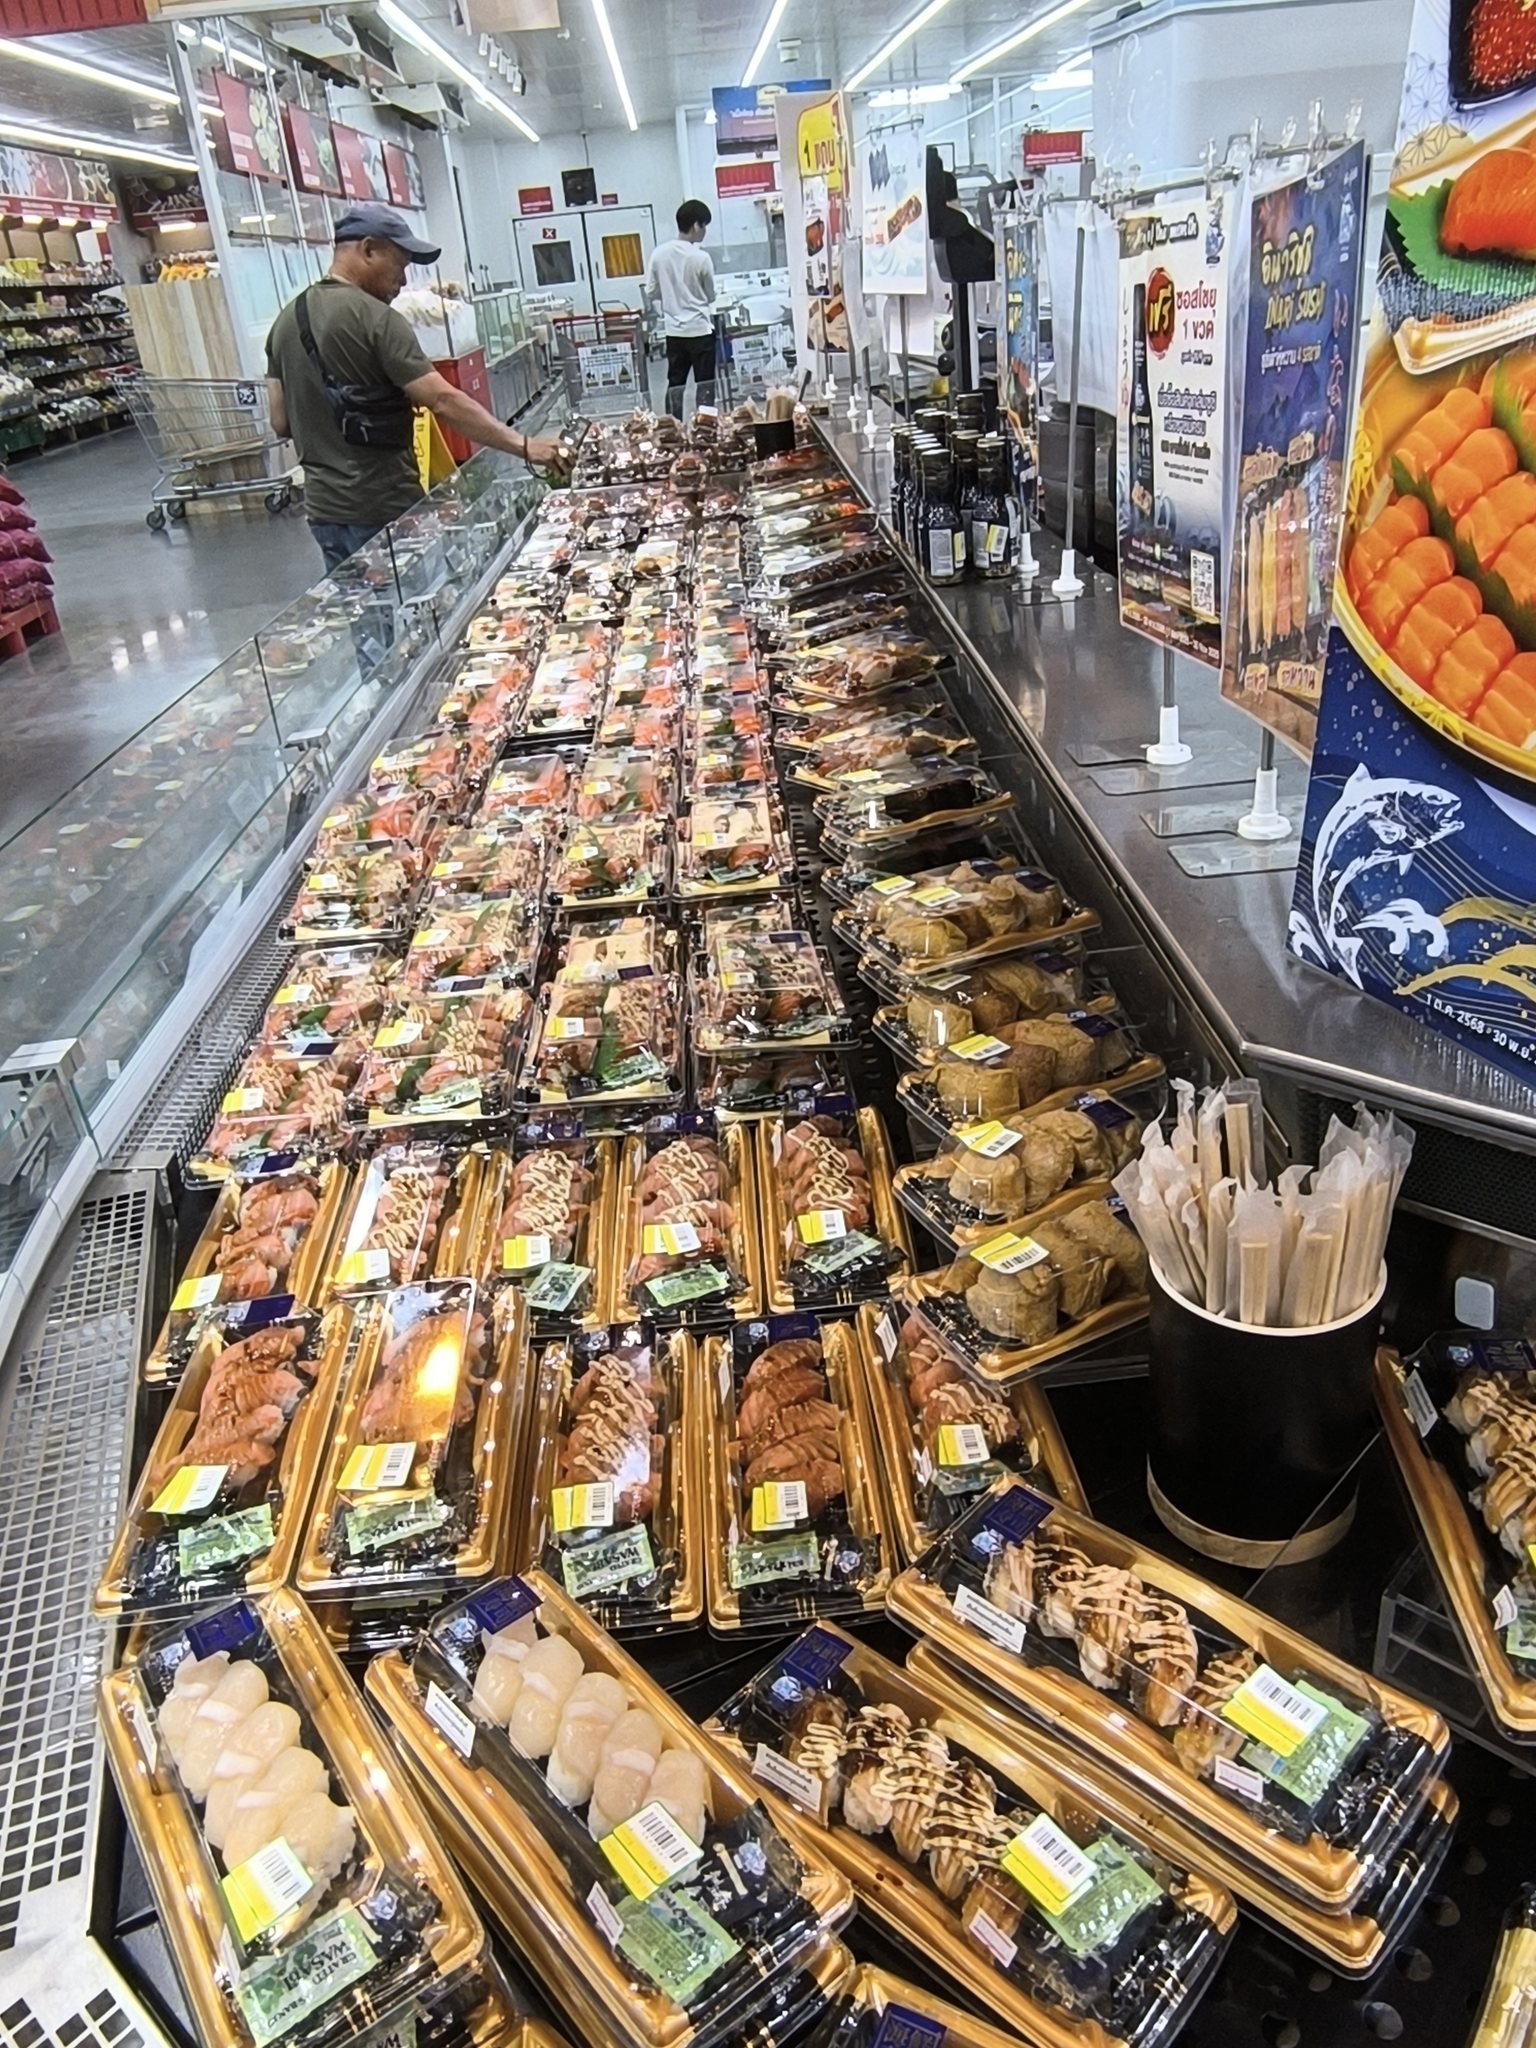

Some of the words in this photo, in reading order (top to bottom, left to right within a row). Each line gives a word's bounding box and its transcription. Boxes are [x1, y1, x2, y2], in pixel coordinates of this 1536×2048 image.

[1149, 281, 1175, 334] ฟรี
[1176, 280, 1217, 318] ซอสโชยุ
[1183, 319, 1188, 341] 1
[1192, 318, 1214, 341] ขวด
[1426, 993, 1433, 1006] 1
[1456, 1010, 1485, 1034] 2568
[1492, 1029, 1507, 1047] 30
[284, 1940, 352, 1992] WASABI
